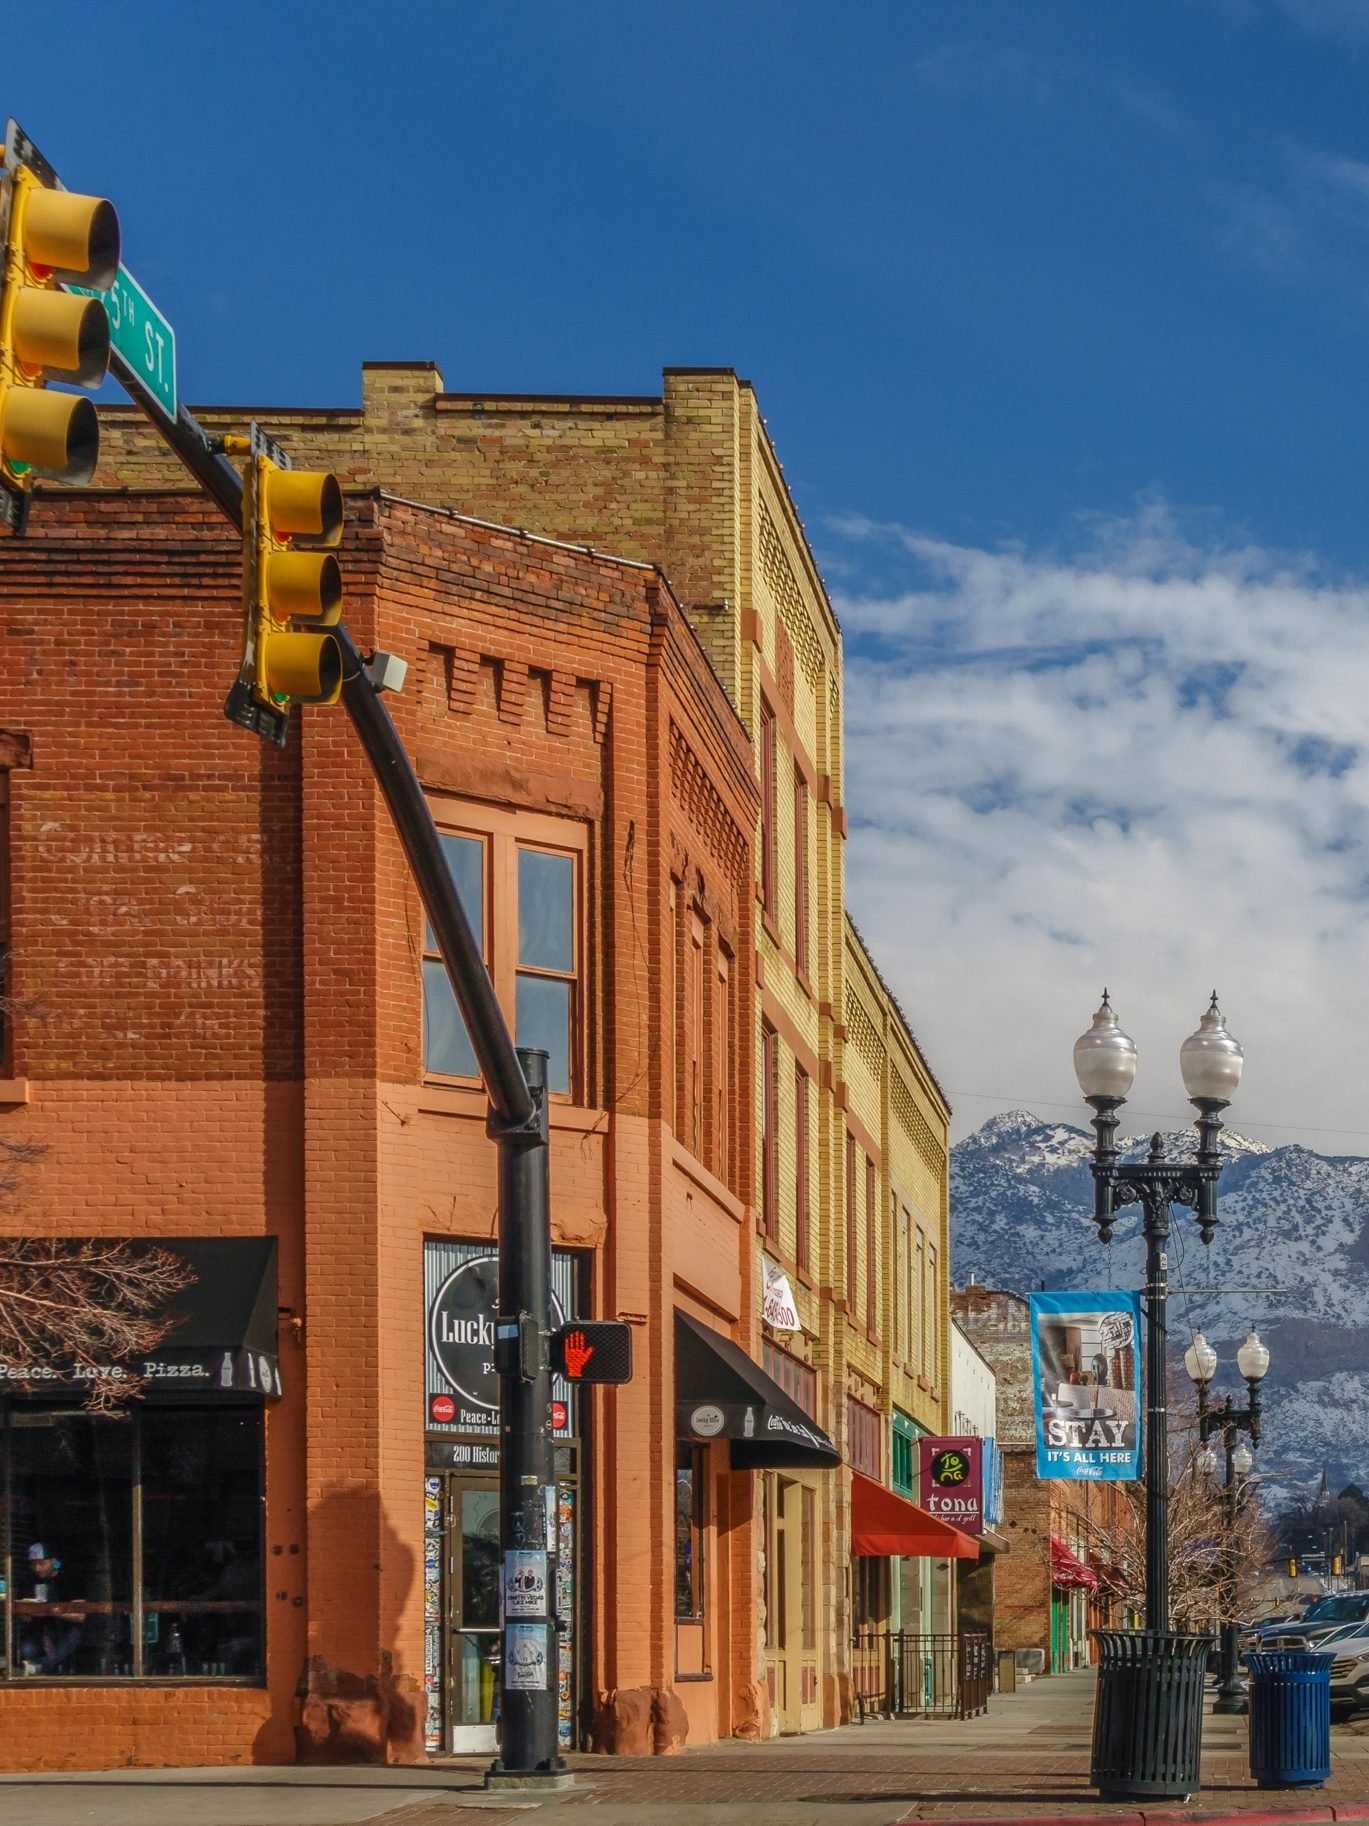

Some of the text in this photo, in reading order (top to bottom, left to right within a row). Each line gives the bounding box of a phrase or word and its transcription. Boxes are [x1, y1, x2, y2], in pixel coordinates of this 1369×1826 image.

[144, 320, 169, 393] ST.
[143, 1362, 210, 1378] Pizza.
[1048, 1419, 1129, 1448] STAY
[453, 1446, 500, 1463] 200 Histor
[1047, 1451, 1131, 1463] IT'S ALL HERE
[926, 1493, 978, 1511] tona
[962, 1514, 976, 1524] grill
